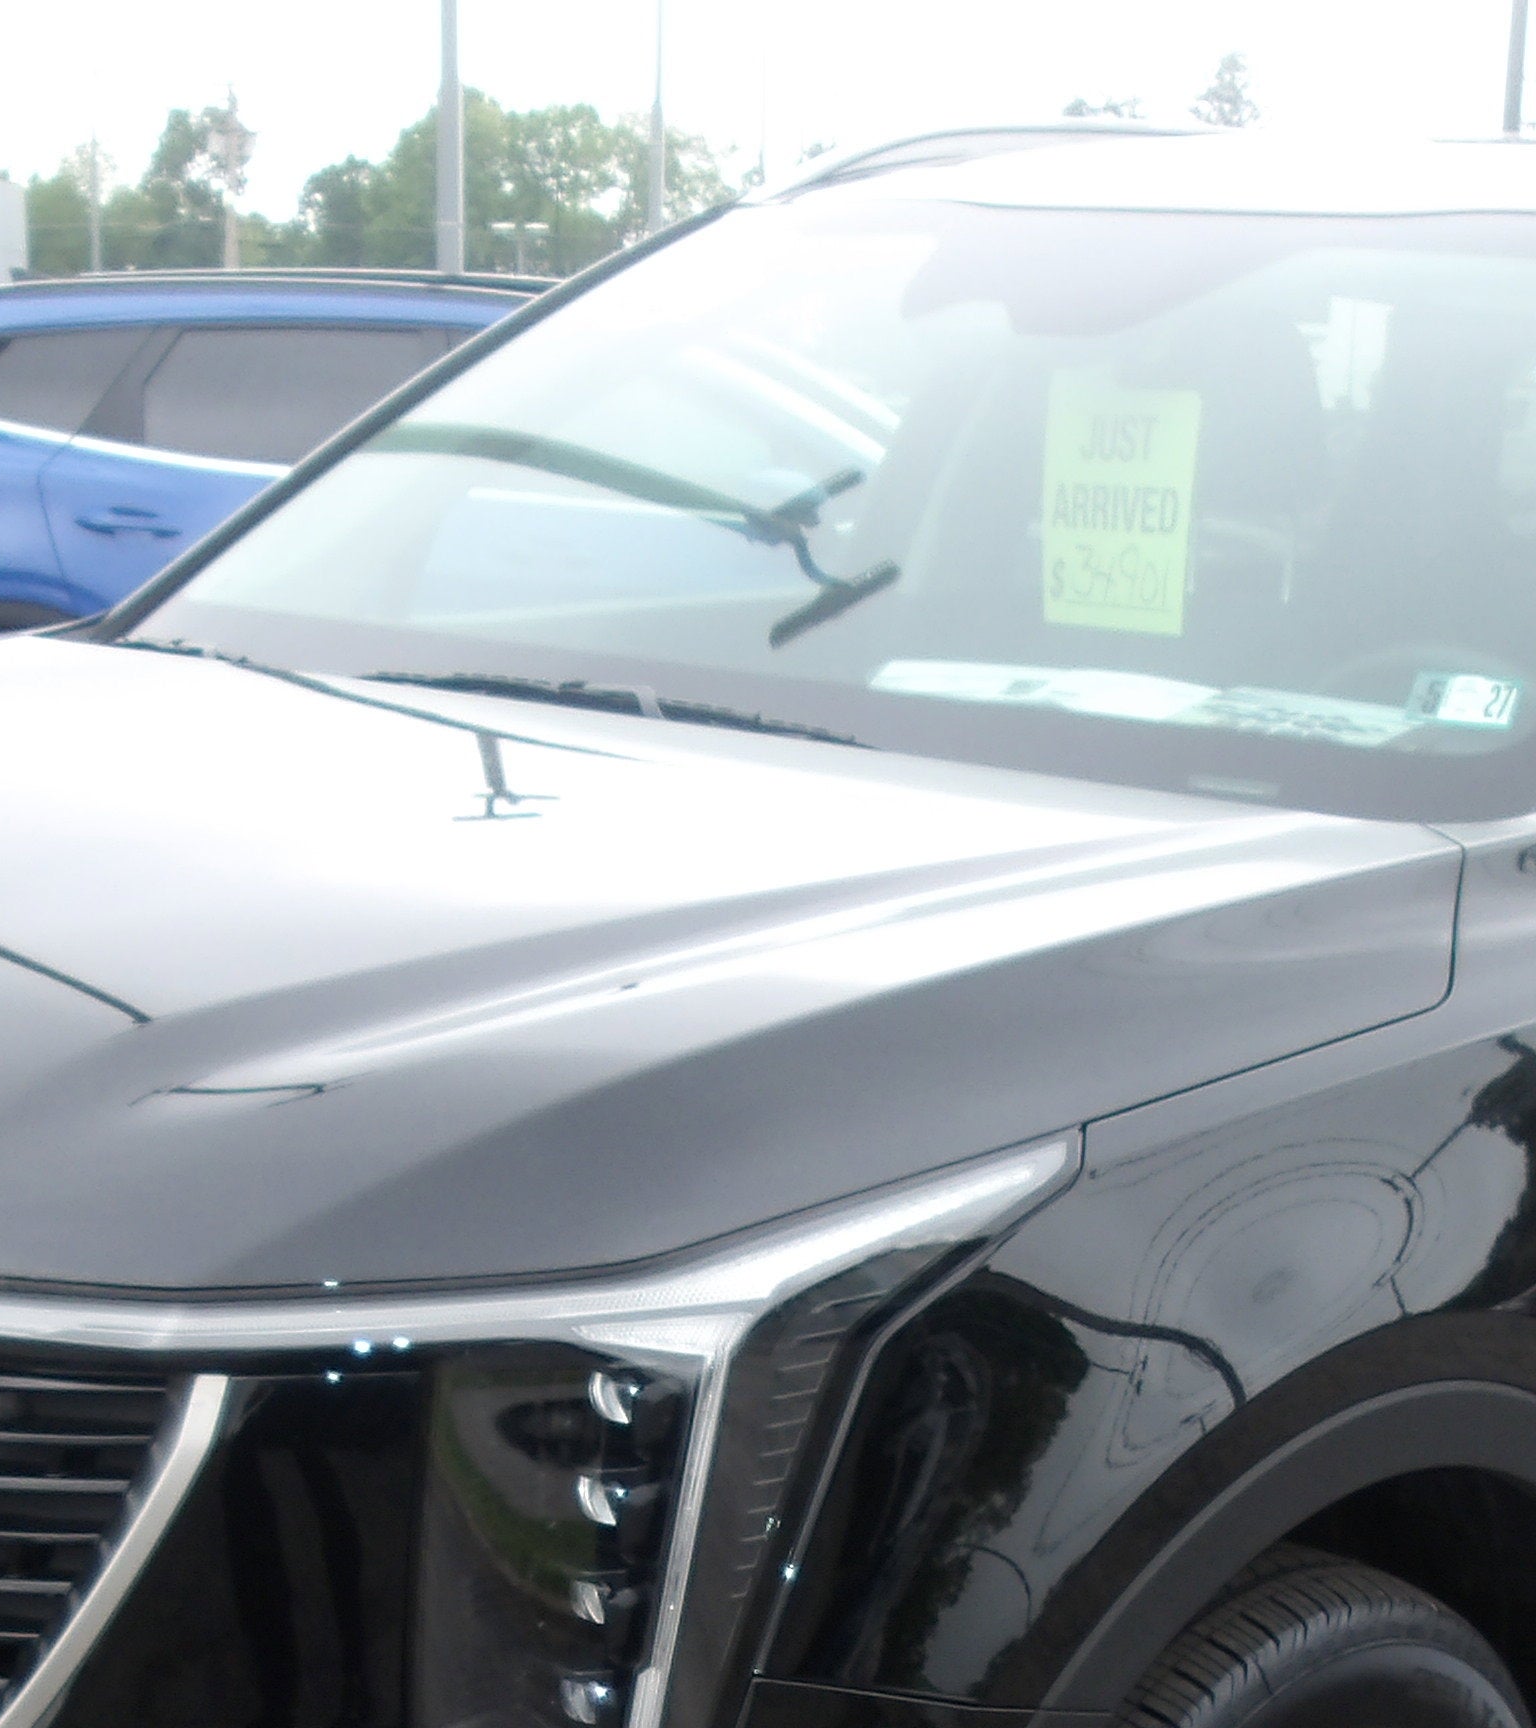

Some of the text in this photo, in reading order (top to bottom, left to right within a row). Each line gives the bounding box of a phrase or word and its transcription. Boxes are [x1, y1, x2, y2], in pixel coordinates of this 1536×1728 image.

[1080, 414, 1160, 462] JUST
[1052, 482, 1179, 534] ARRIVED
[1484, 684, 1518, 719] 27
